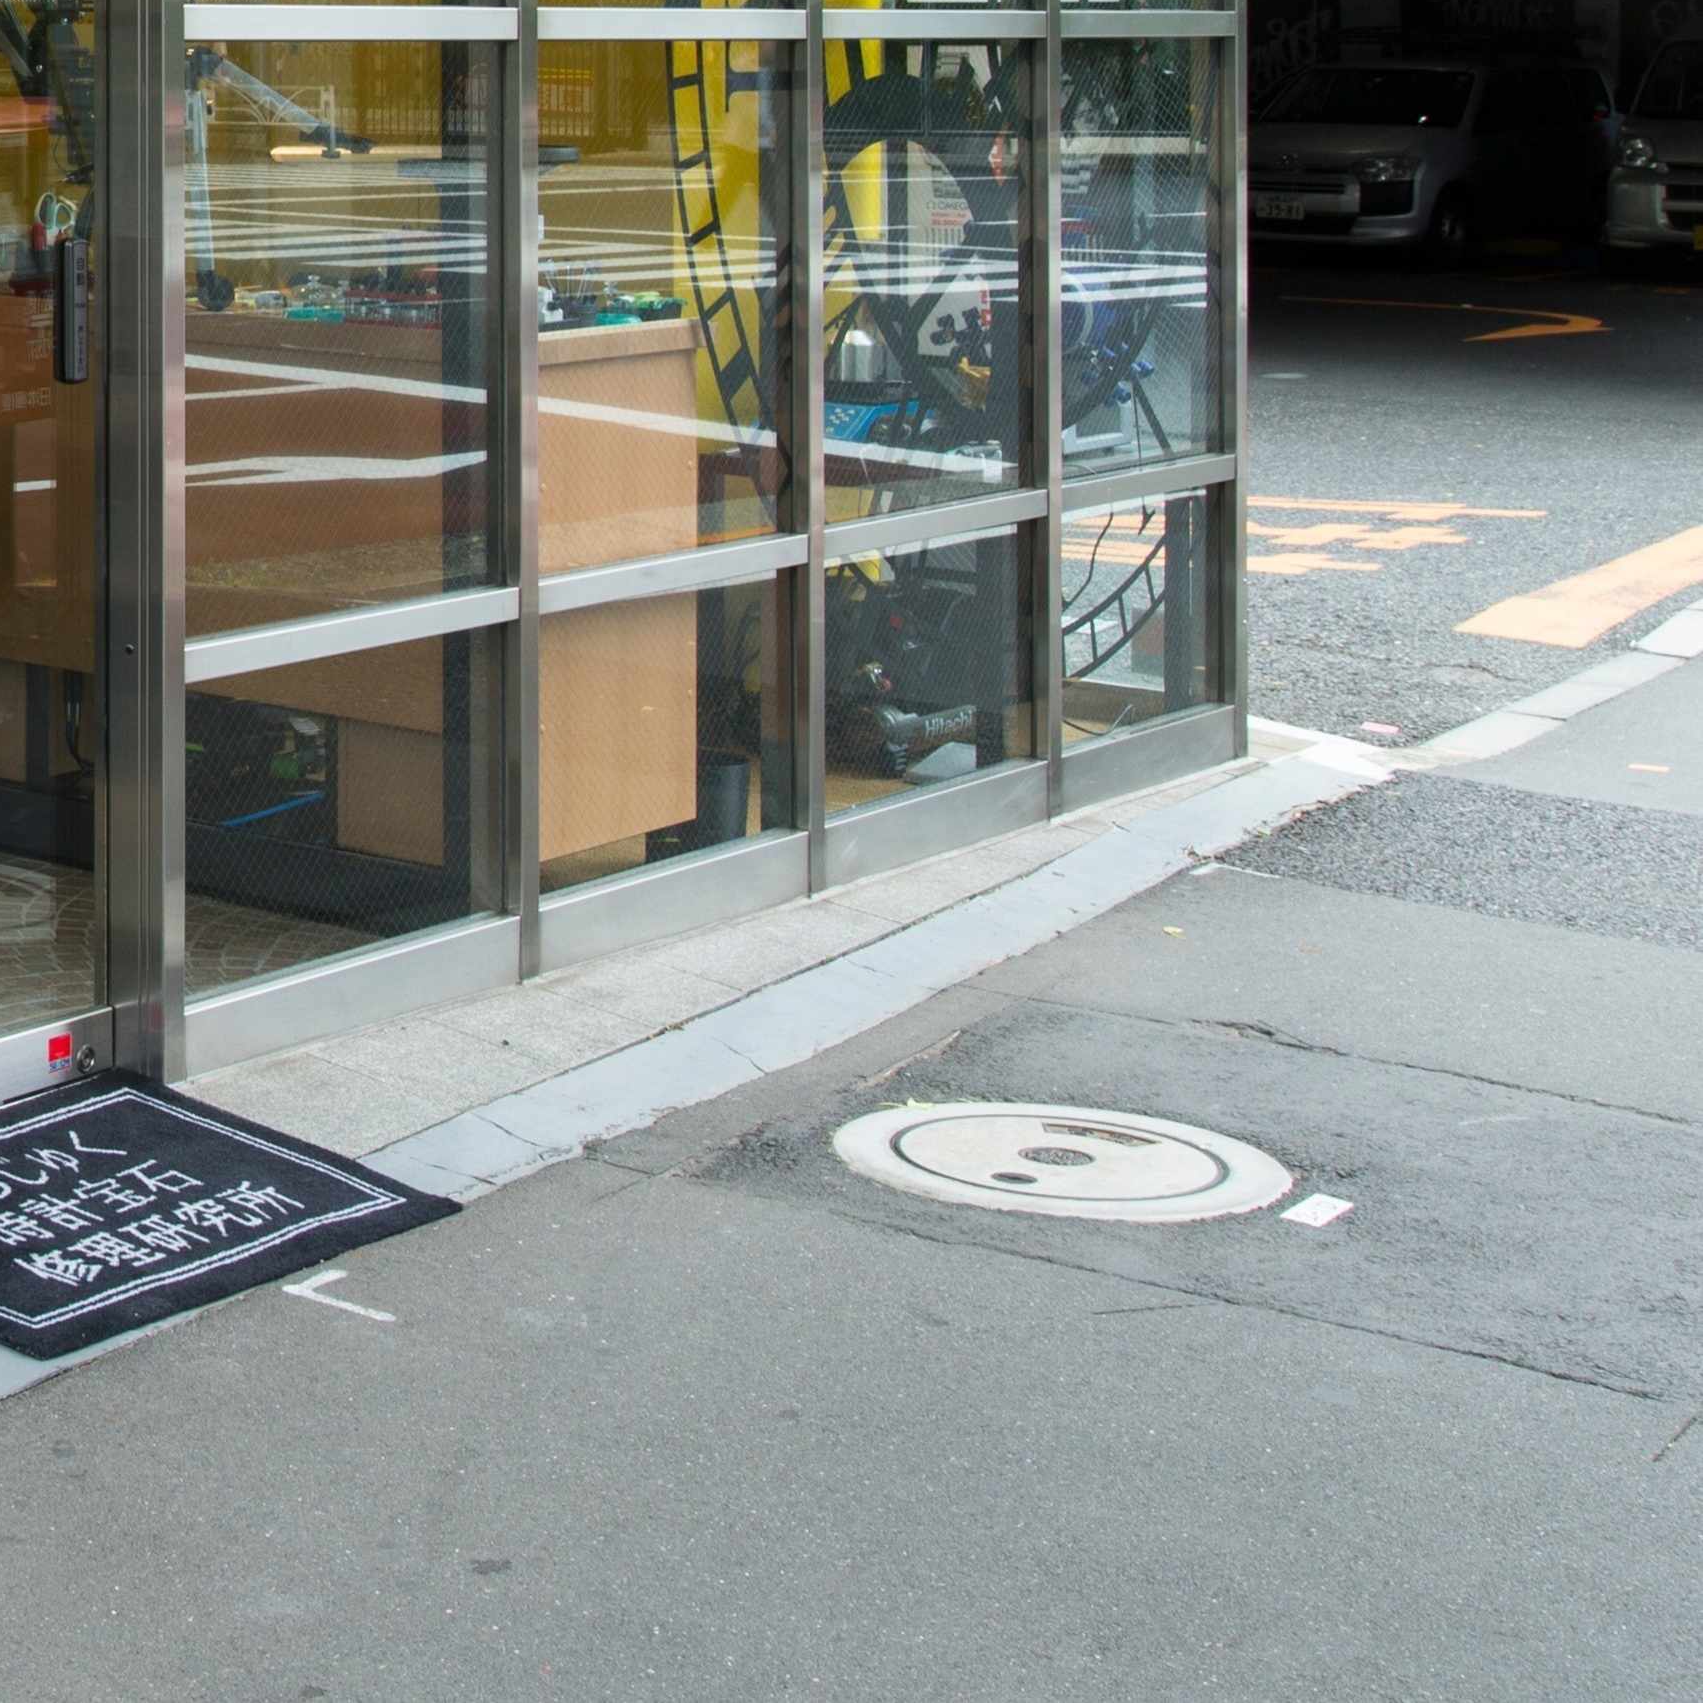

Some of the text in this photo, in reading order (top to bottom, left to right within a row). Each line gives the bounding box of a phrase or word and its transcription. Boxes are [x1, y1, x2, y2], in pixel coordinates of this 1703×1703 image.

[12, 1181, 305, 1286] 修理研究所
